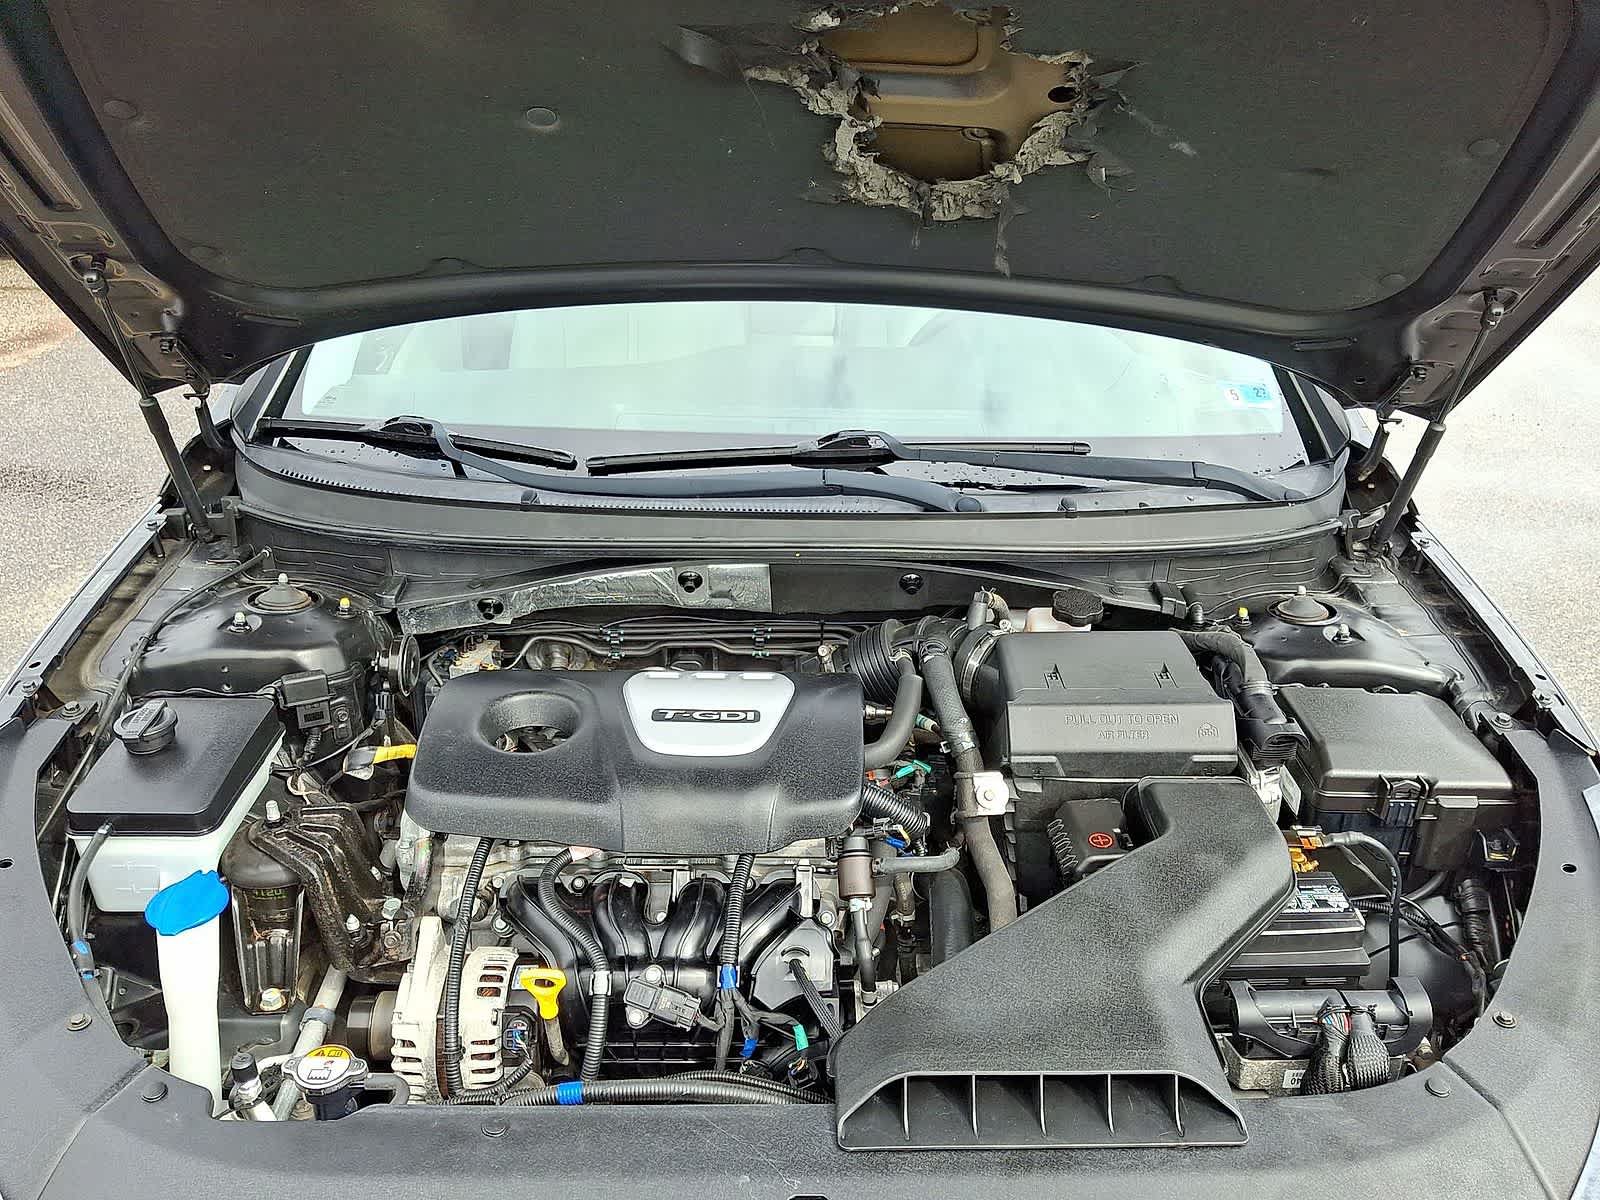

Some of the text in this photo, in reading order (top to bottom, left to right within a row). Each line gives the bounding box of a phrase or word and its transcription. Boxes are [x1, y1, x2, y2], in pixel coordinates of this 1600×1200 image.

[658, 709, 755, 722] T-GDI
[1064, 713, 1180, 726] PULL OUT TO OPEN
